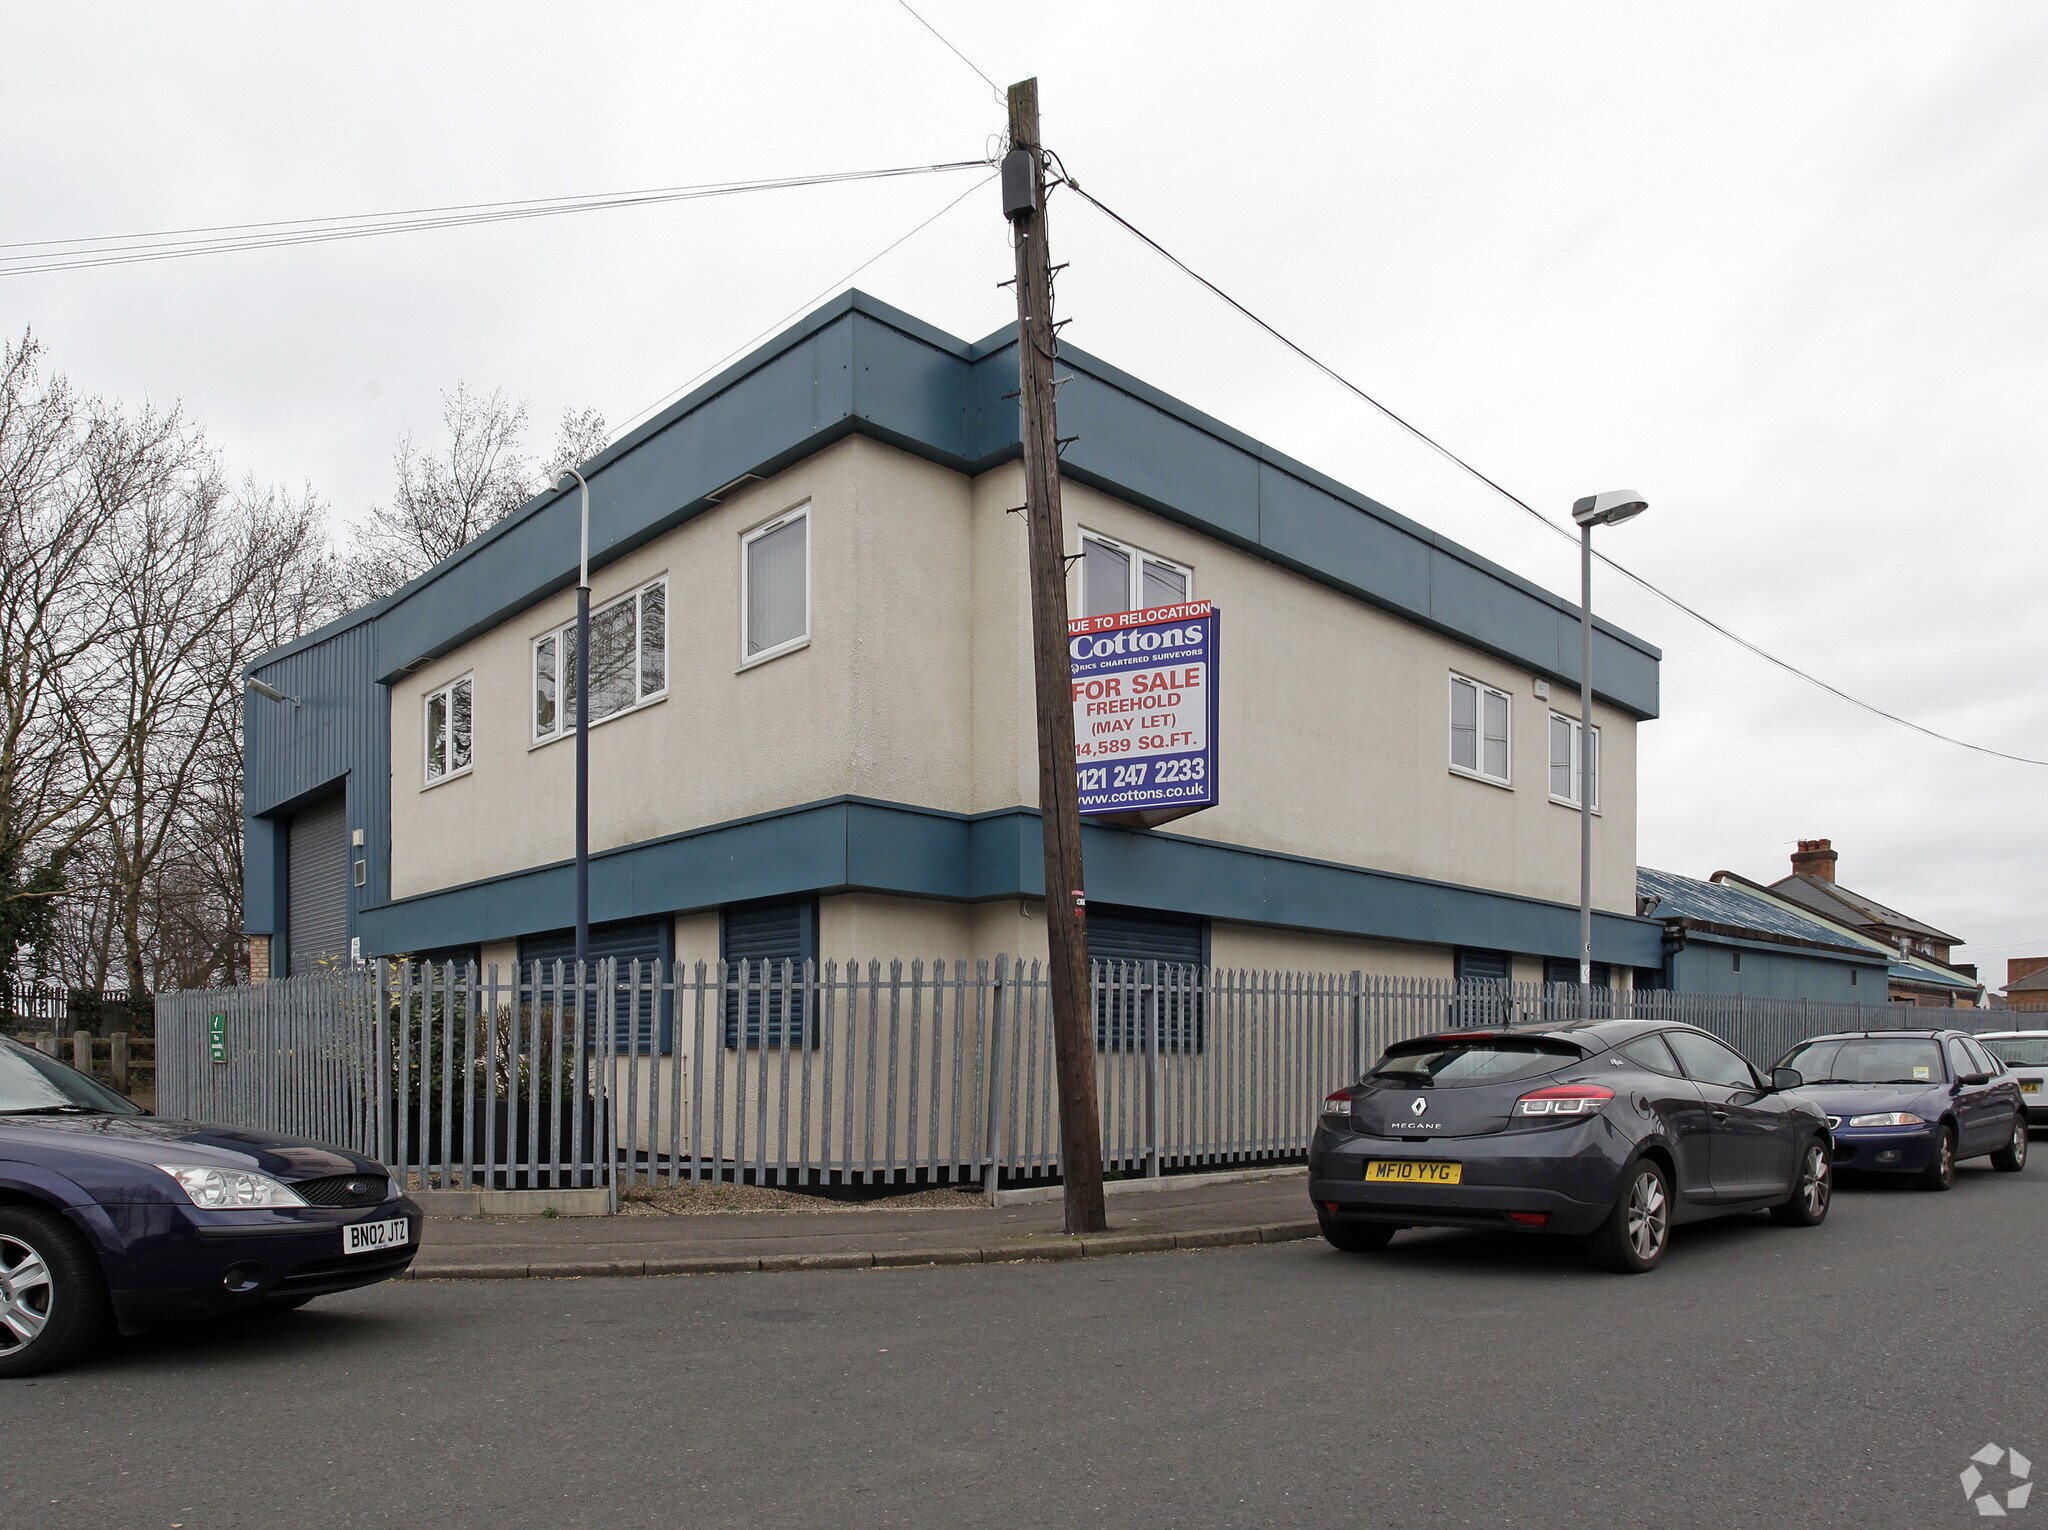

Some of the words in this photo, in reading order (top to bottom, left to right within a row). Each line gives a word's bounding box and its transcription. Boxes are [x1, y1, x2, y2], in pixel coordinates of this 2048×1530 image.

[1095, 616, 1114, 629] TO
[1119, 601, 1211, 626] RELOCATION
[1069, 624, 1203, 660] Cottons
[1080, 662, 1097, 671] RICS
[1100, 655, 1150, 668] CHARTERED
[1152, 648, 1203, 661] SURVEYORS
[1072, 677, 1121, 702] FOR
[1132, 667, 1200, 694] SALE
[1086, 692, 1182, 717] FREEHOLD
[1091, 717, 1135, 737] (MAY
[1141, 713, 1176, 729] LET)
[1074, 738, 1131, 757] 14,589
[1138, 731, 1197, 750] SQ.FT.
[1076, 767, 1107, 791] 121
[1113, 763, 1148, 788] 247
[1154, 757, 1205, 784] 2233
[1391, 1122, 1442, 1130] MEGANE
[1376, 1163, 1413, 1178] MF10
[1418, 1164, 1451, 1180] YYG
[351, 1223, 385, 1248] BN02
[388, 1220, 406, 1242] JTZ
